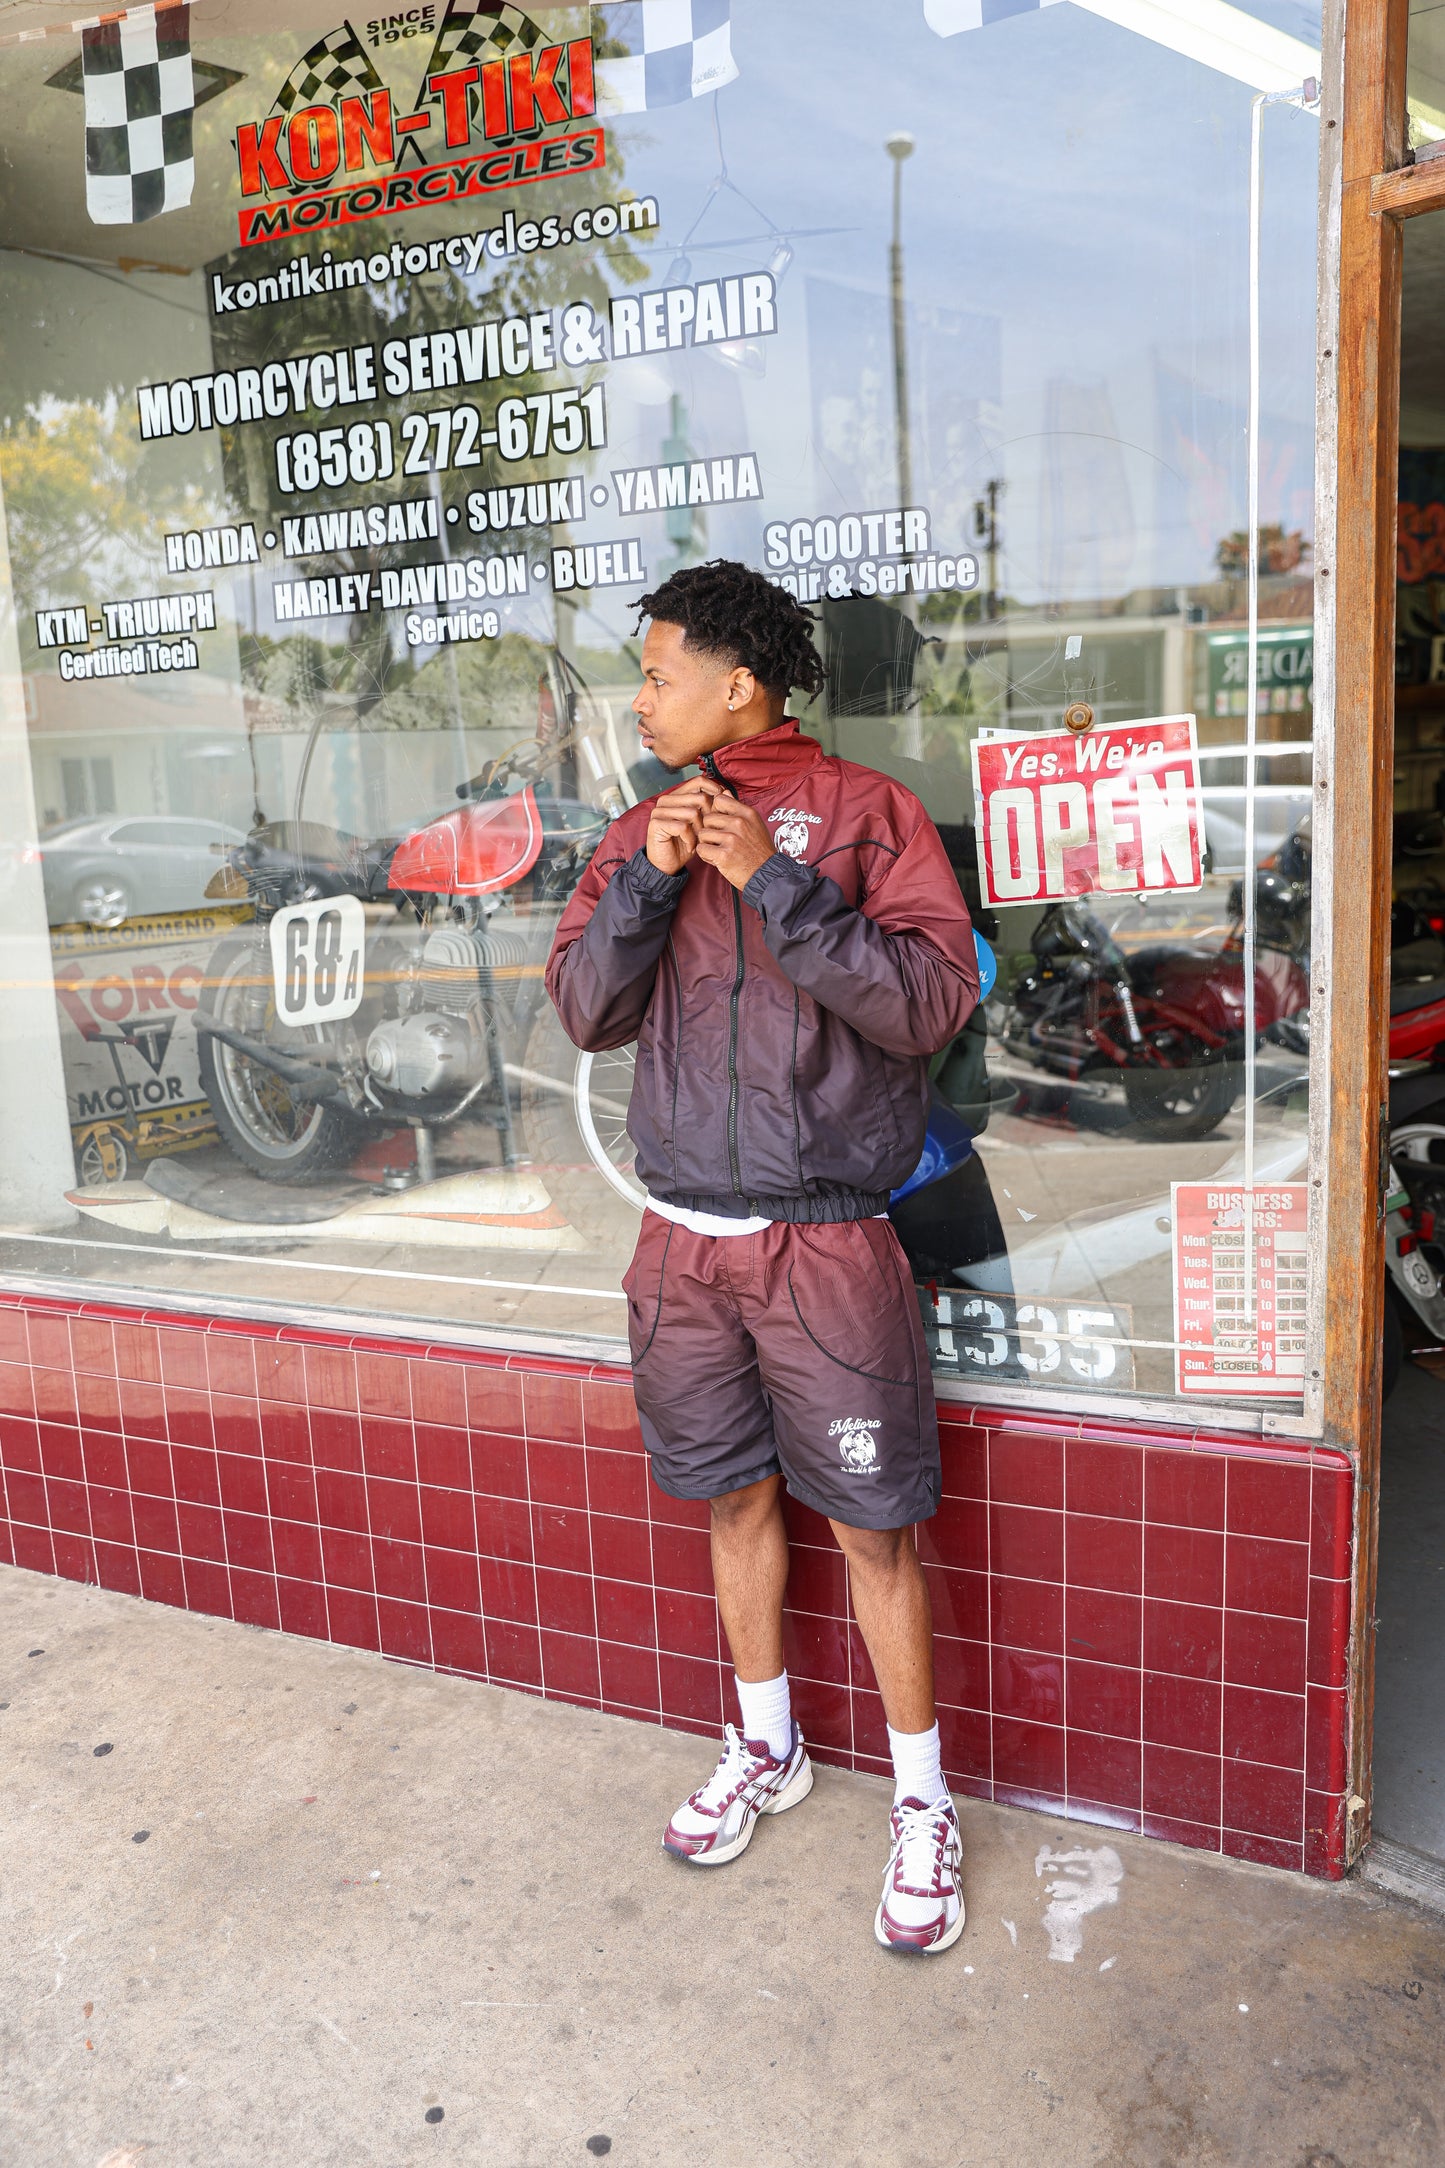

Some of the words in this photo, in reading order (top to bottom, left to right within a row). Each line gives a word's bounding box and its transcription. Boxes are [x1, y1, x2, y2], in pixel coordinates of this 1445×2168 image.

[366, 5, 436, 36] SINCE
[367, 19, 436, 48] 1965
[234, 36, 597, 198] KON-TIKI
[246, 137, 598, 242] MOTORCYCLES
[213, 197, 659, 314] kontikimotorcycles.com
[139, 345, 376, 440] MOTORCYCLE
[383, 311, 554, 394] SERVICE
[560, 303, 606, 366] &
[610, 272, 778, 360] REPAIR
[275, 421, 396, 493] (858)
[402, 383, 608, 478] 272-6751
[165, 522, 260, 573] HONDA
[282, 495, 440, 560] KAWASAKI
[467, 476, 585, 535] SUZUKI
[612, 453, 763, 514] YAMAHA
[765, 506, 931, 568] SCOOTER
[274, 552, 528, 622] HARLEY-DAVIDSON
[552, 539, 646, 592] BUELL
[827, 564, 852, 598] &
[858, 554, 978, 597] Service
[36, 608, 87, 647] KTM
[103, 592, 215, 641] TRIUMPH
[407, 610, 499, 647] Service
[60, 645, 145, 680] Certified
[147, 641, 199, 671] Tech
[1002, 746, 1064, 781] Yes,
[1074, 736, 1164, 773] We're
[768, 808, 822, 824] Meliora
[989, 770, 1194, 898] OPEN
[85, 917, 216, 947] RECOMMEND
[79, 1076, 184, 1117] MOTOR
[1183, 1256, 1211, 1268] Tues.
[1260, 1257, 1271, 1268] to
[1183, 1277, 1210, 1289] Wed.
[1260, 1278, 1272, 1290] to
[1184, 1299, 1211, 1310] Thur.
[1261, 1299, 1272, 1310] to
[931, 1296, 1117, 1378] 1335
[1183, 1320, 1203, 1331] Fri.
[1261, 1320, 1272, 1331] to
[1261, 1340, 1272, 1351] to
[1185, 1360, 1208, 1370] Sun.
[1213, 1362, 1259, 1371] CLOSED
[828, 1417, 882, 1436] Meliora
